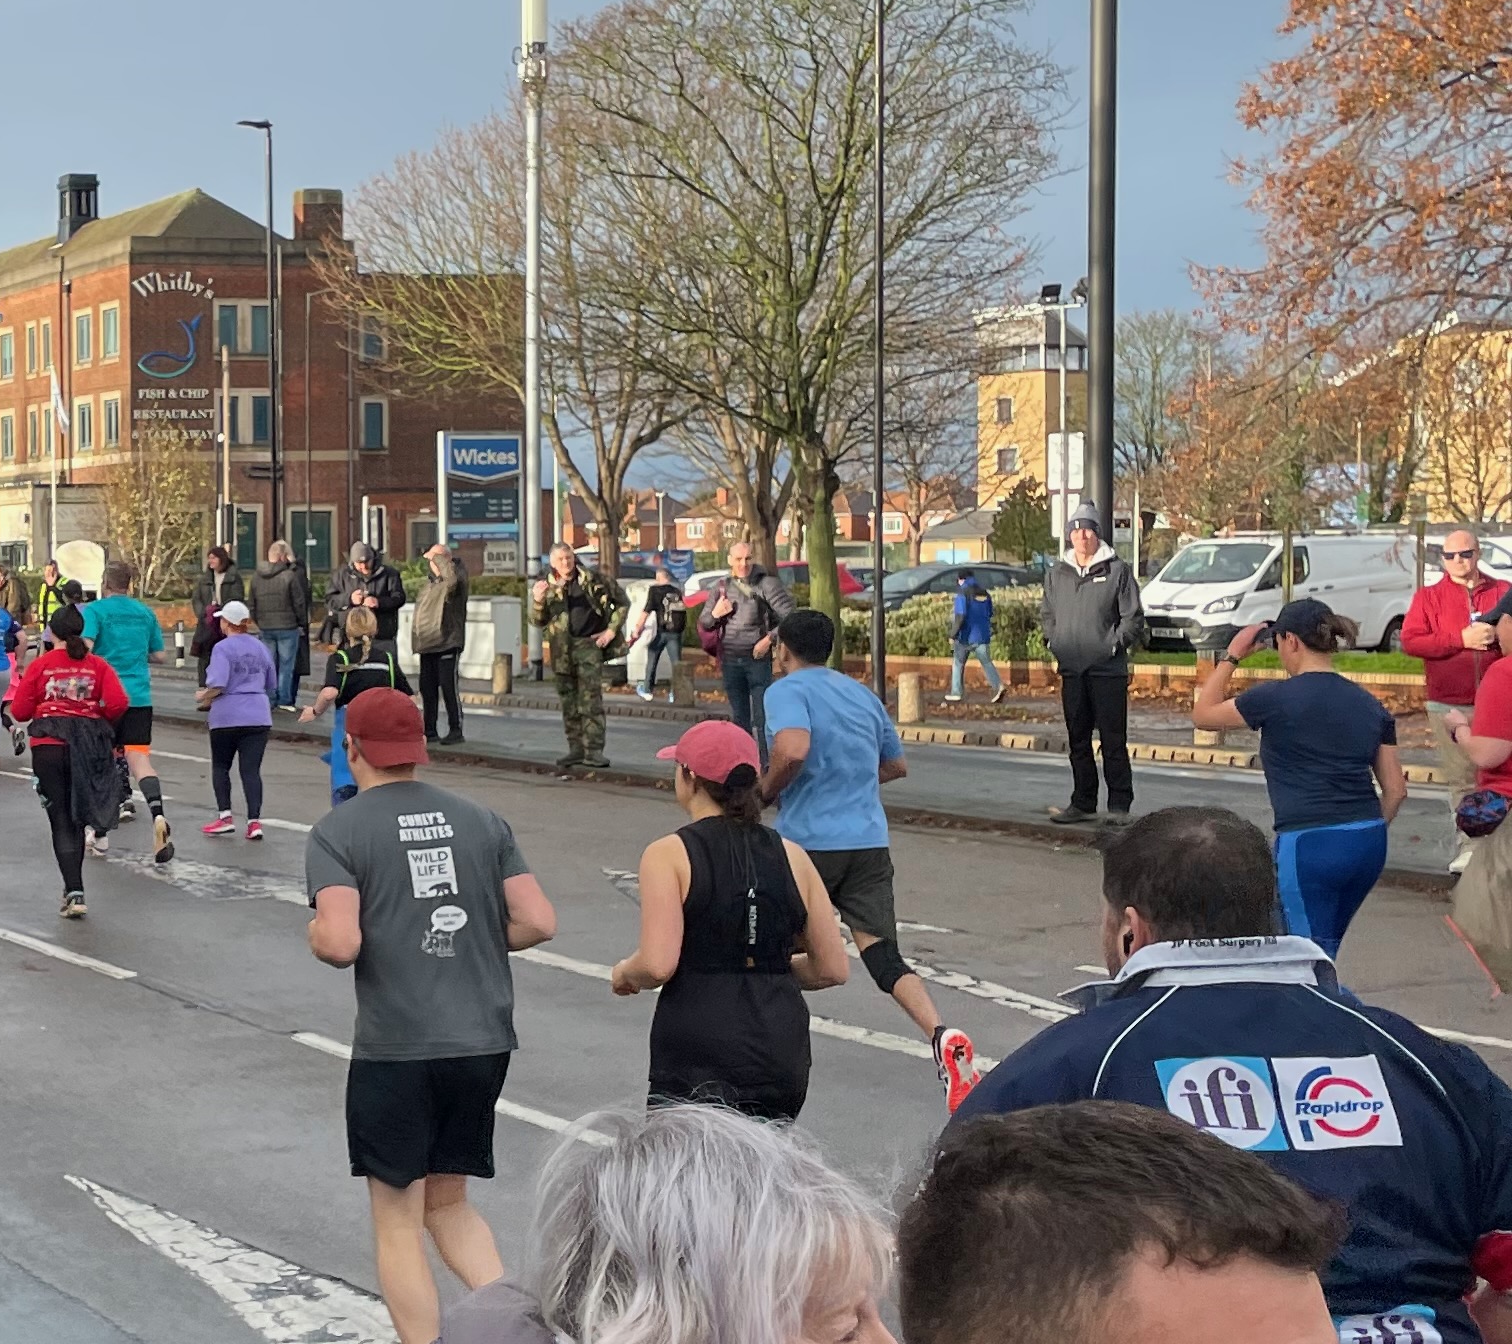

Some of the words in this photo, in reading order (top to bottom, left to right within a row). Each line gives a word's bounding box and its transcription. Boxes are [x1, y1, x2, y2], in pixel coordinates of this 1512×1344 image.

[131, 271, 214, 299] Whitby's
[138, 389, 166, 399] FISH
[168, 389, 177, 399] &
[179, 389, 209, 399] CHIP
[133, 409, 214, 419] RESTAURANT
[453, 448, 517, 465] Wickes
[398, 811, 445, 827] CURLY'S
[399, 824, 454, 842] ATHLETES
[411, 850, 449, 864] WILD
[417, 863, 448, 876] LIFE
[1179, 1067, 1267, 1130] ifi
